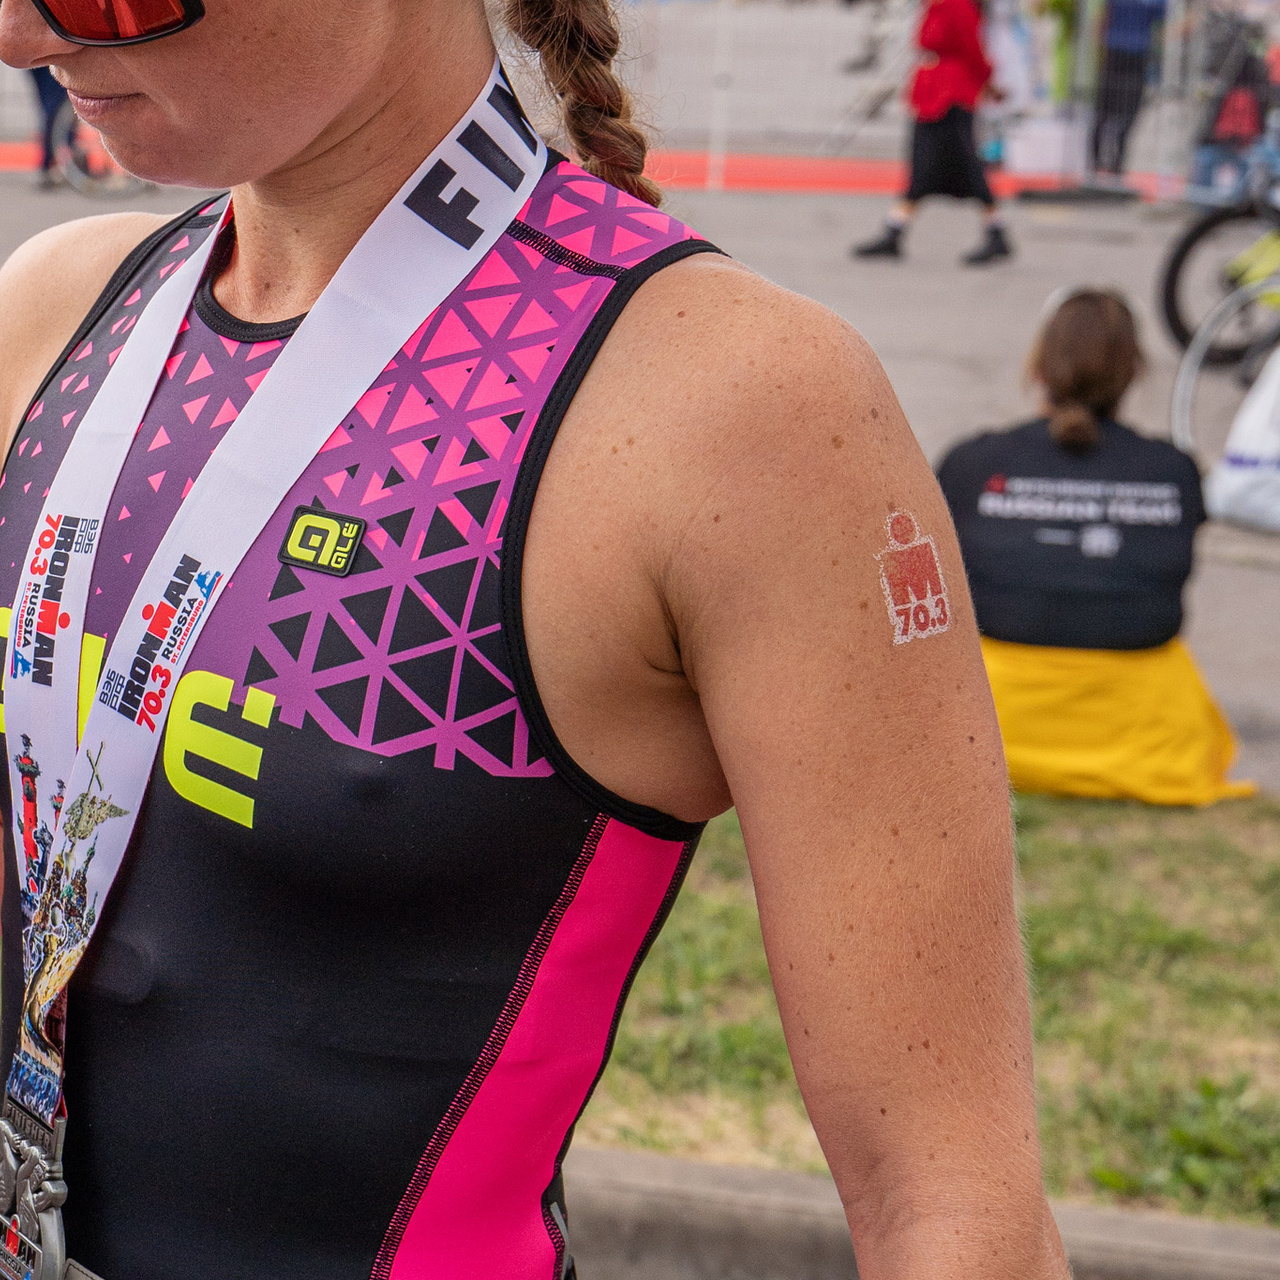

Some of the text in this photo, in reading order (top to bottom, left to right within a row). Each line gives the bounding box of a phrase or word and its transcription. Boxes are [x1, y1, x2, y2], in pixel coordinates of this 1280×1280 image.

[30, 514, 63, 576] 70.3
[22, 583, 42, 649] RUSSIA
[32, 515, 80, 687] IRONMAN
[161, 597, 199, 660] RUSSIA
[895, 597, 948, 637] 70.3
[118, 554, 202, 723] IRONMAN
[136, 664, 171, 734] 70.3
